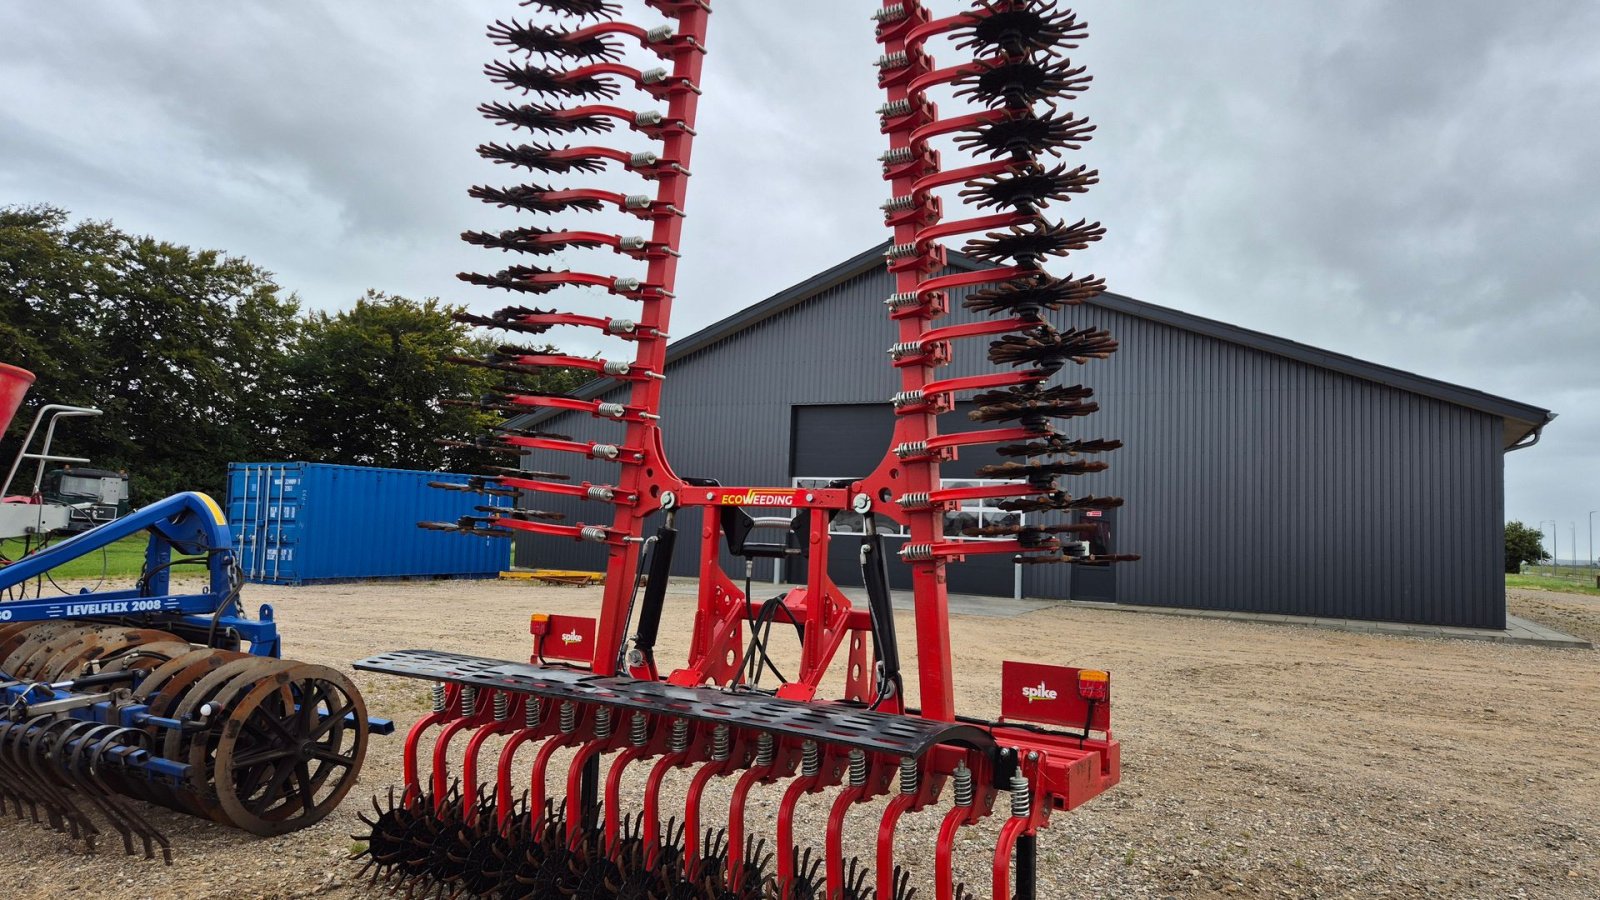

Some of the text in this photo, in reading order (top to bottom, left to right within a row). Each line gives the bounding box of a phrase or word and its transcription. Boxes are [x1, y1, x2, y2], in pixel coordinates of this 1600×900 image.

[721, 490, 793, 505] ECOWEEDING
[66, 602, 128, 616] LEVELFLEX
[131, 600, 161, 612] 2008
[561, 628, 583, 646] spike
[1022, 680, 1058, 704] spike
